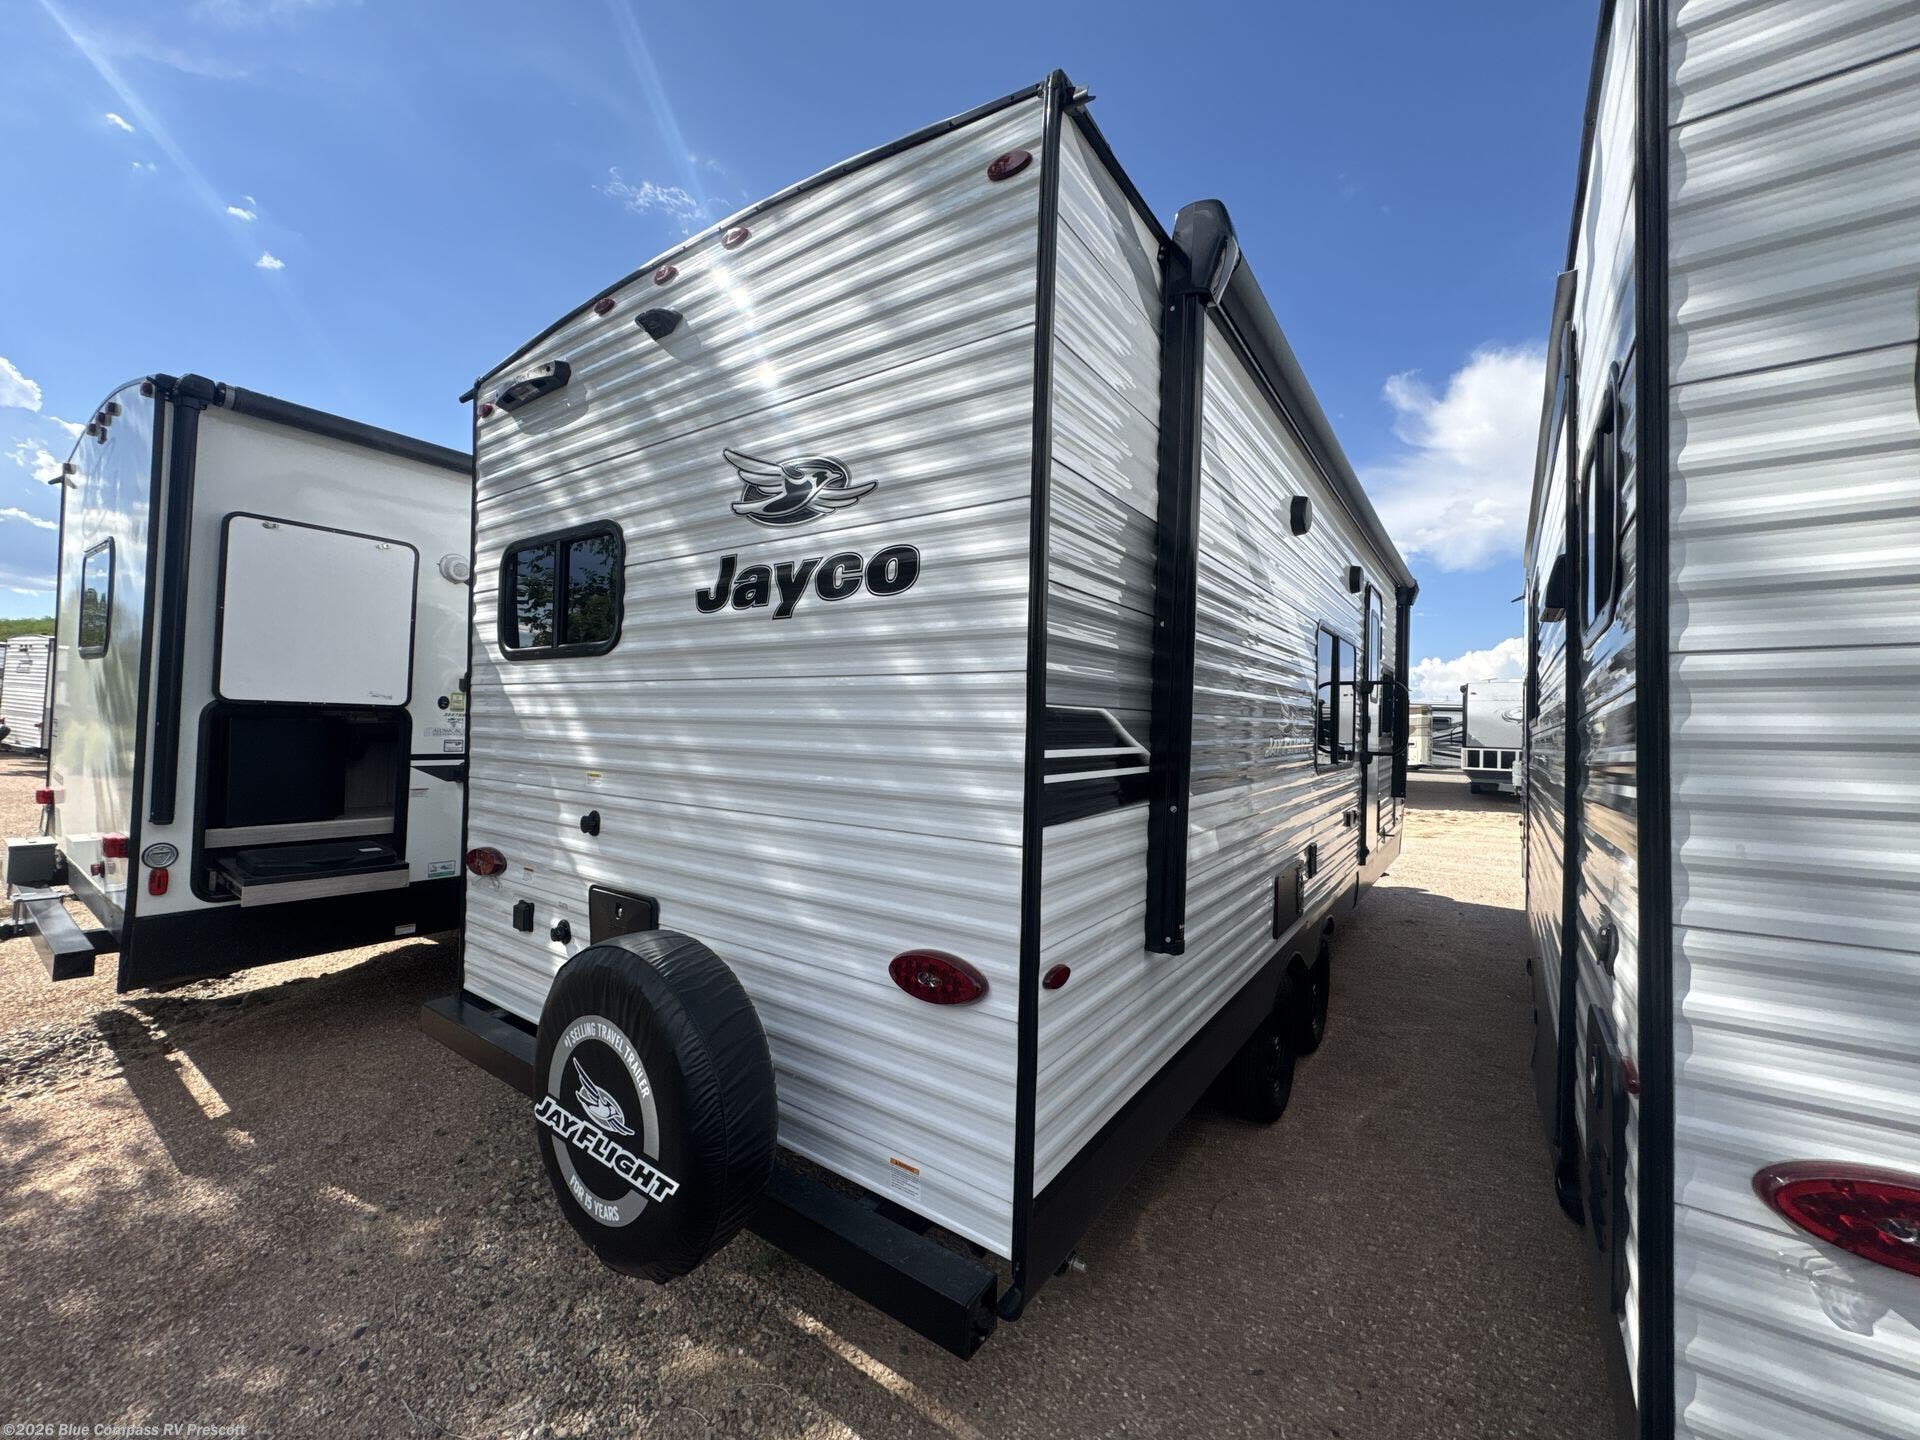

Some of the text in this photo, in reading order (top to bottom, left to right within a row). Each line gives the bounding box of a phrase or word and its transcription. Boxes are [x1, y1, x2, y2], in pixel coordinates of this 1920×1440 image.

[695, 544, 921, 620] Jayco
[569, 1022, 597, 1044] SELLING
[597, 1023, 624, 1053] TRAVEL
[624, 1045, 650, 1099] TRAILER
[569, 1174, 620, 1221] FOR 15 YEARS
